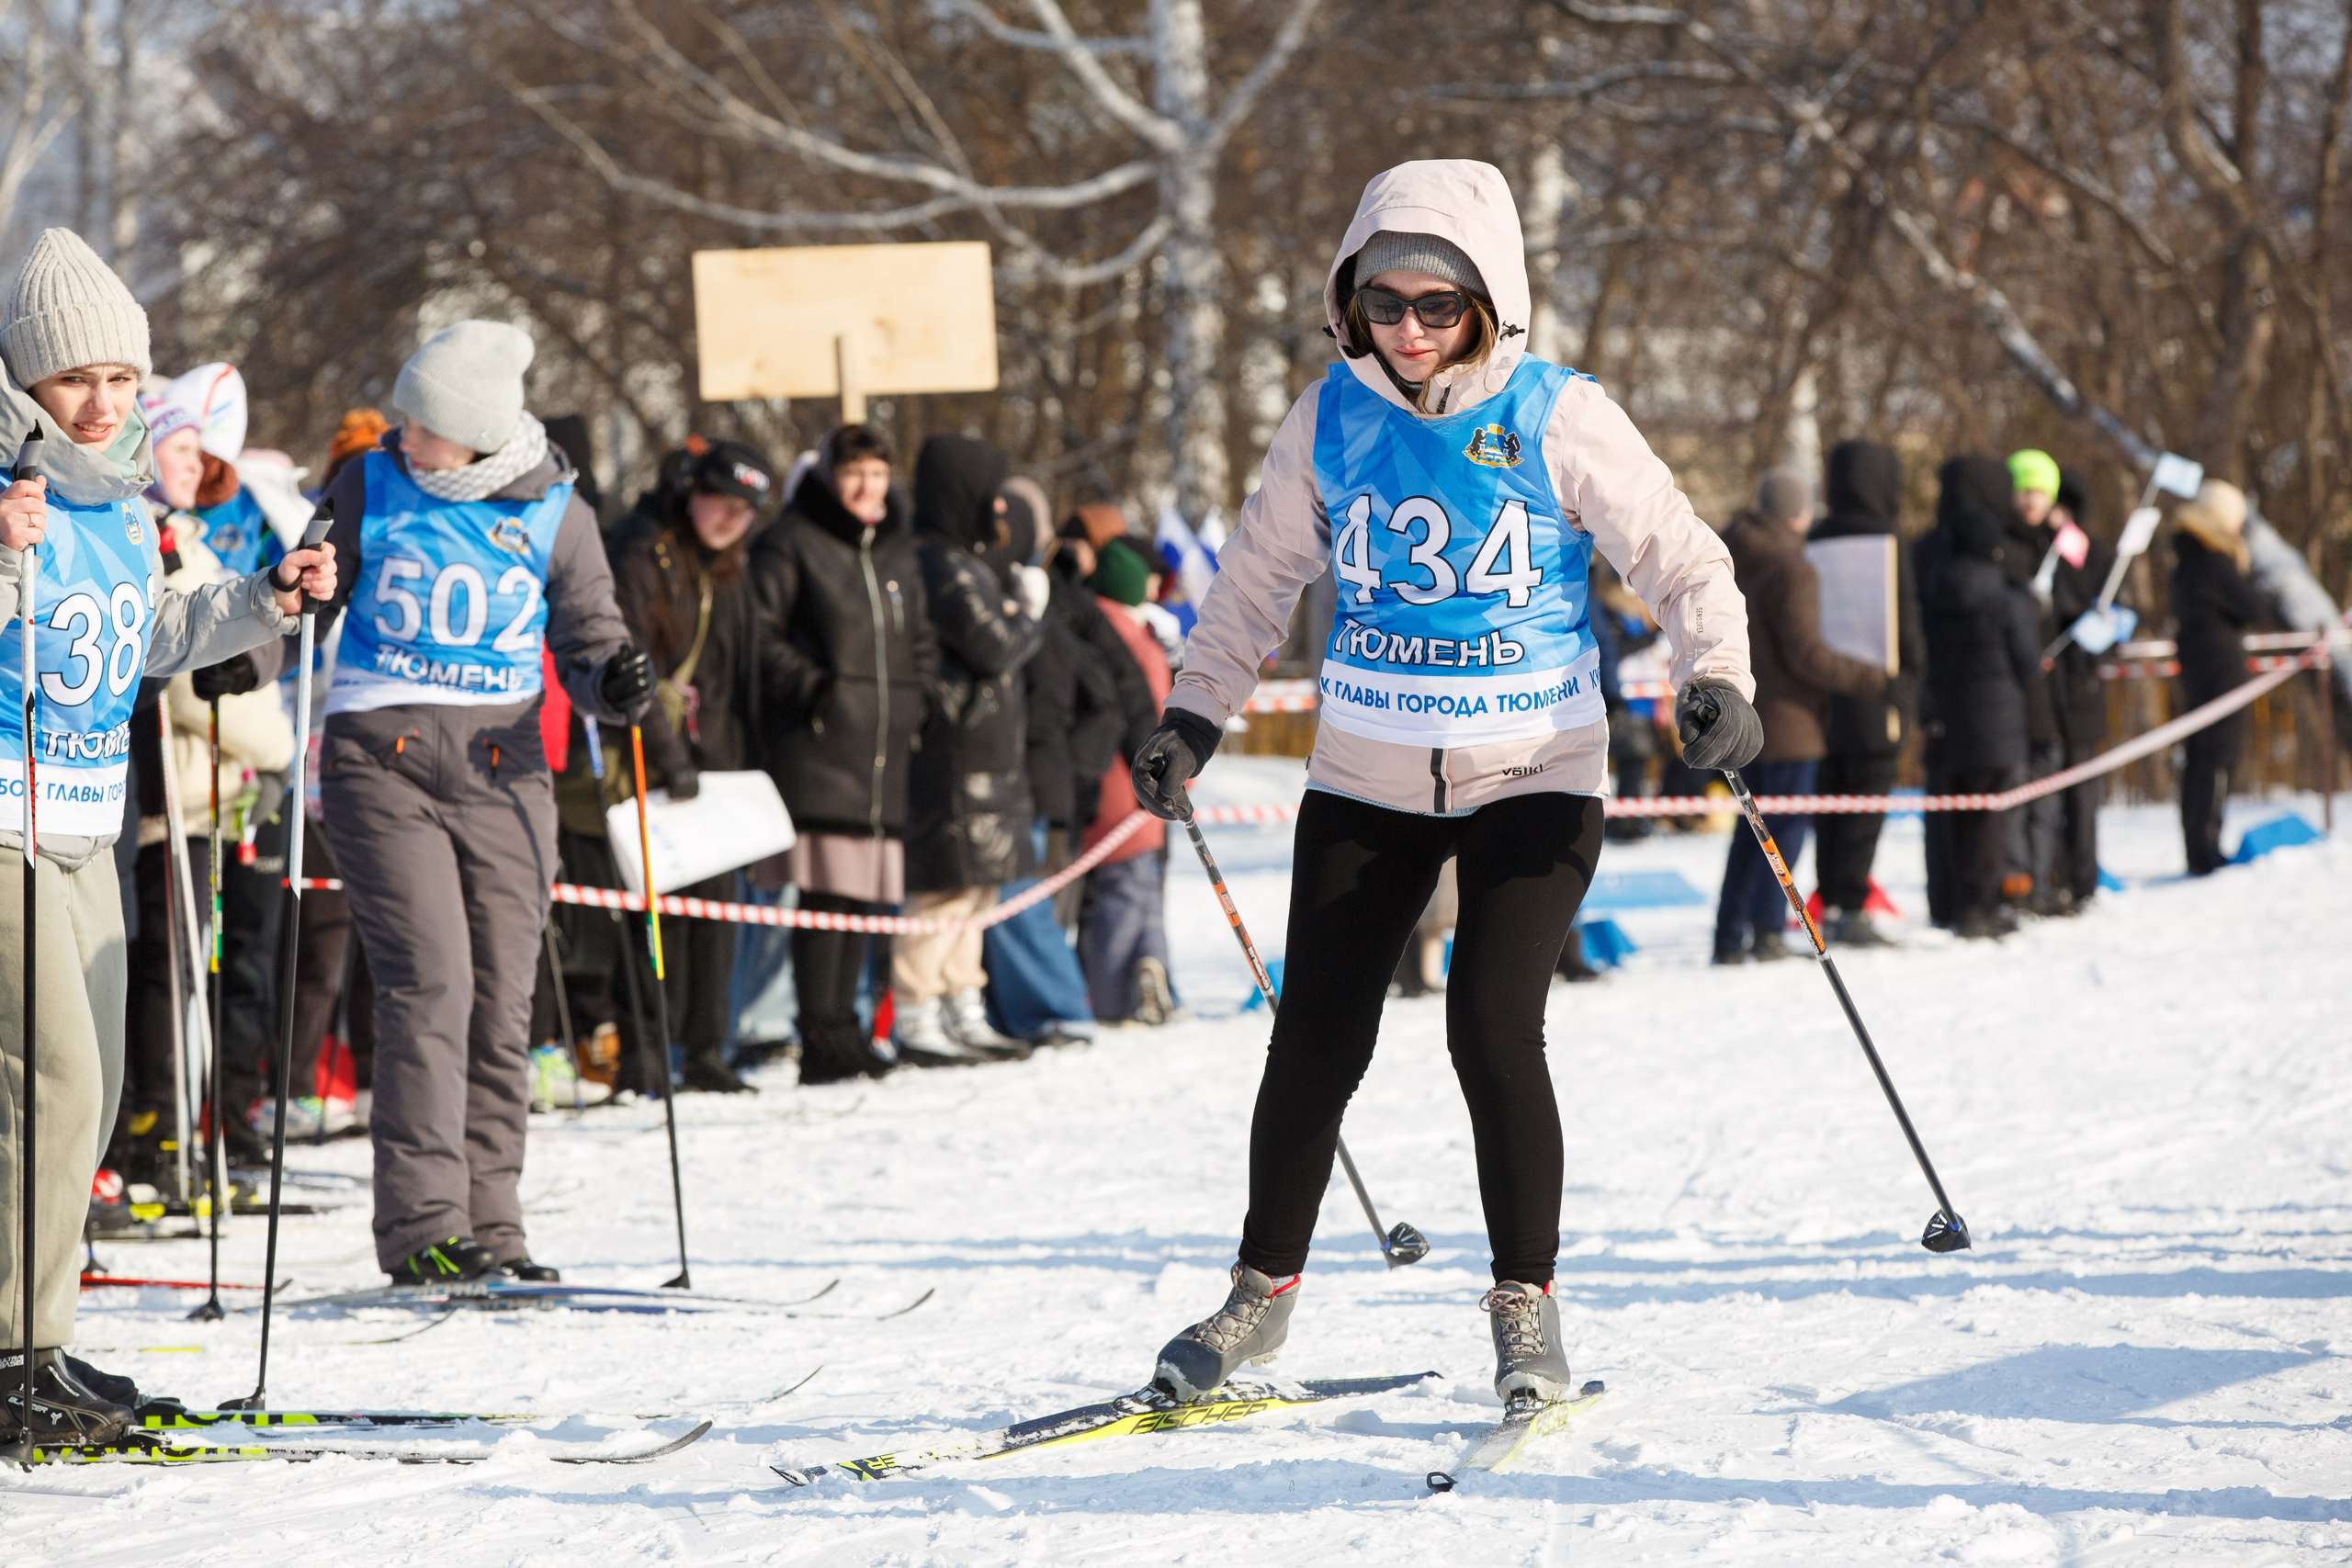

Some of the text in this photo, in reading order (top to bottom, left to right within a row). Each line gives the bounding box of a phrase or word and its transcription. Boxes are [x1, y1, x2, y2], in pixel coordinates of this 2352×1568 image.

[1335, 493, 1544, 608] 434
[372, 557, 541, 653] 502
[1334, 618, 1525, 668] ТЮМЕНЬ
[375, 645, 525, 690] ТЮМЕНЬ
[1336, 681, 1390, 709] ГЛАВЫ
[1397, 694, 1488, 717] ГОРОДА
[1497, 676, 1580, 713] ТЮМЕНИ
[1502, 763, 1544, 776] völkl
[48, 783, 104, 803] ГЛАВЫ
[1129, 1404, 1268, 1435] FISCHER
